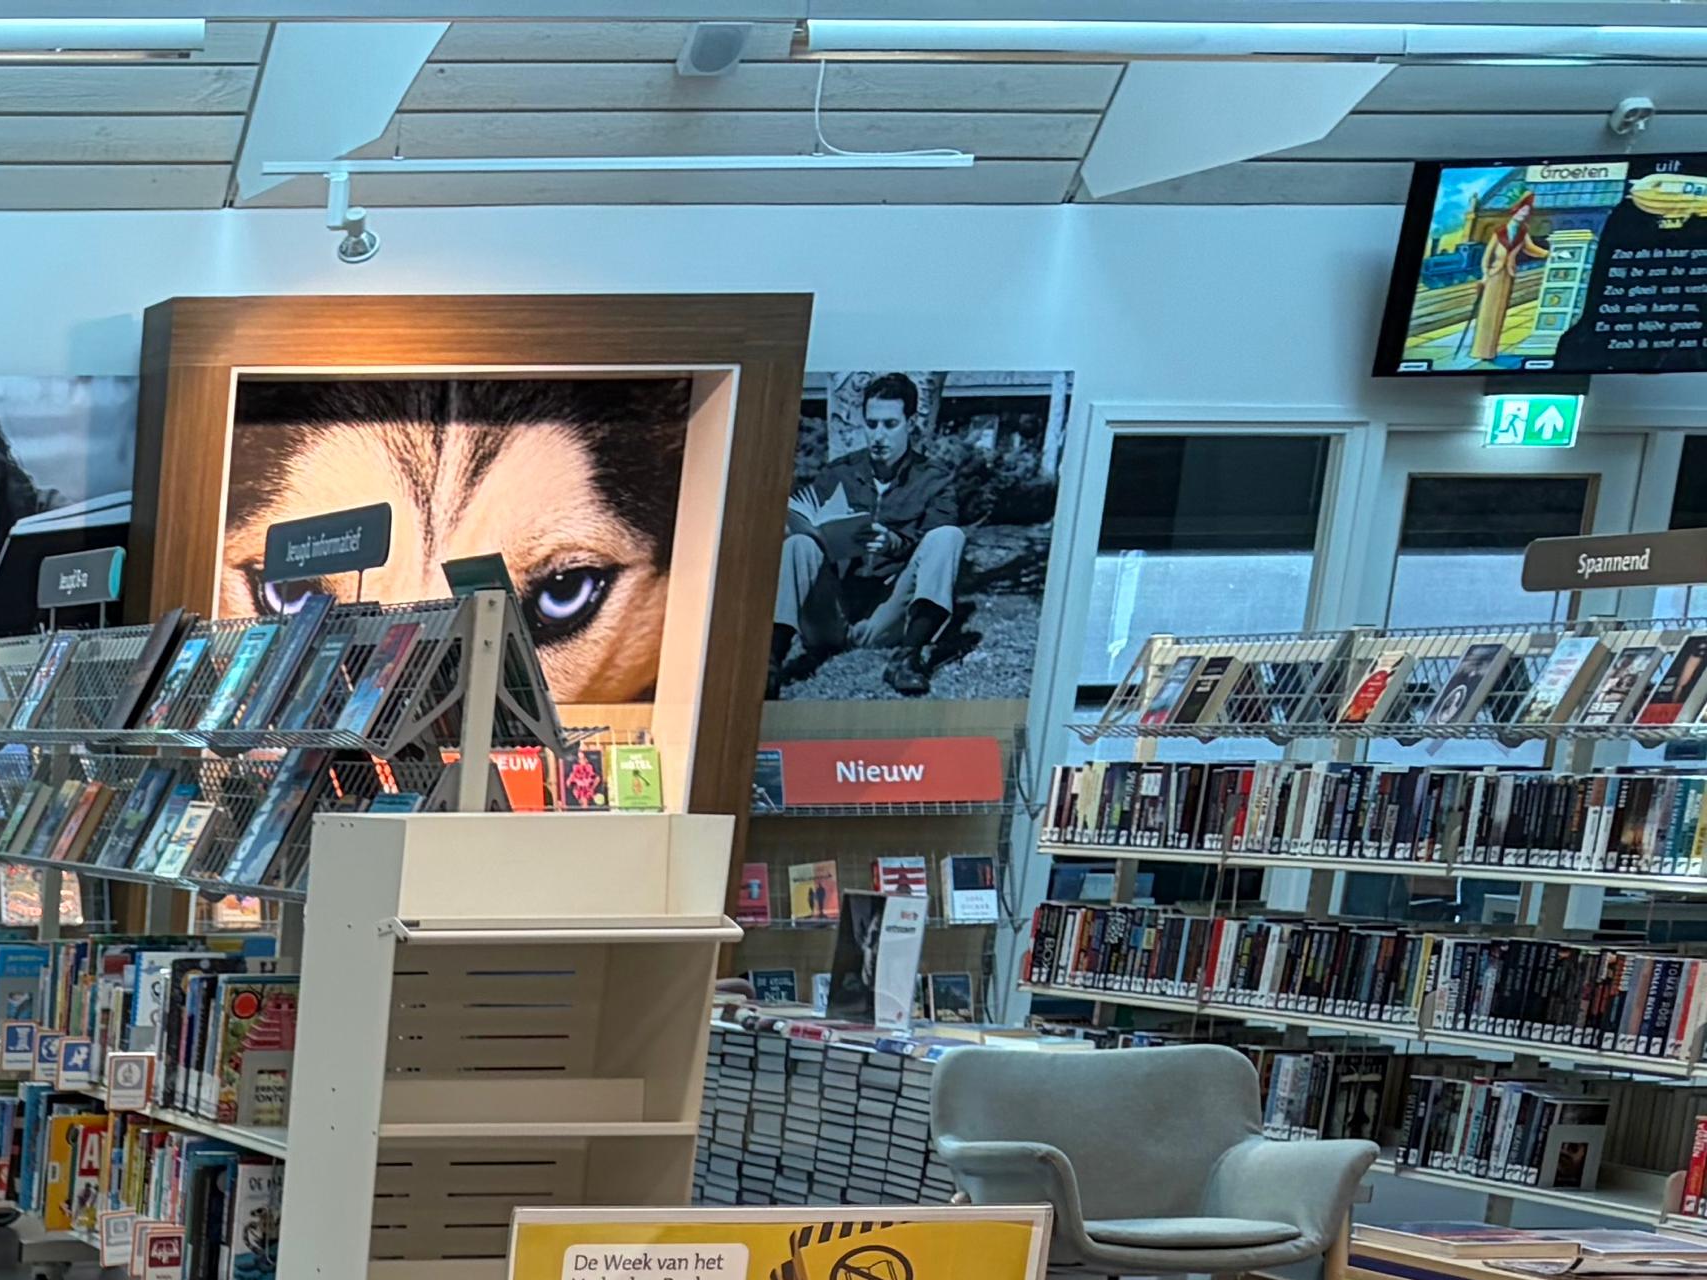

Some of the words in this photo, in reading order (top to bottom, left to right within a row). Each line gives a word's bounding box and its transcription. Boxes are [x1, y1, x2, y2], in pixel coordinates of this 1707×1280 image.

[1540, 166, 1608, 179] Groeten
[1656, 160, 1681, 172] uit
[1576, 550, 1651, 577] Spannend
[497, 757, 538, 771] EUW
[835, 760, 925, 784] Nieuw
